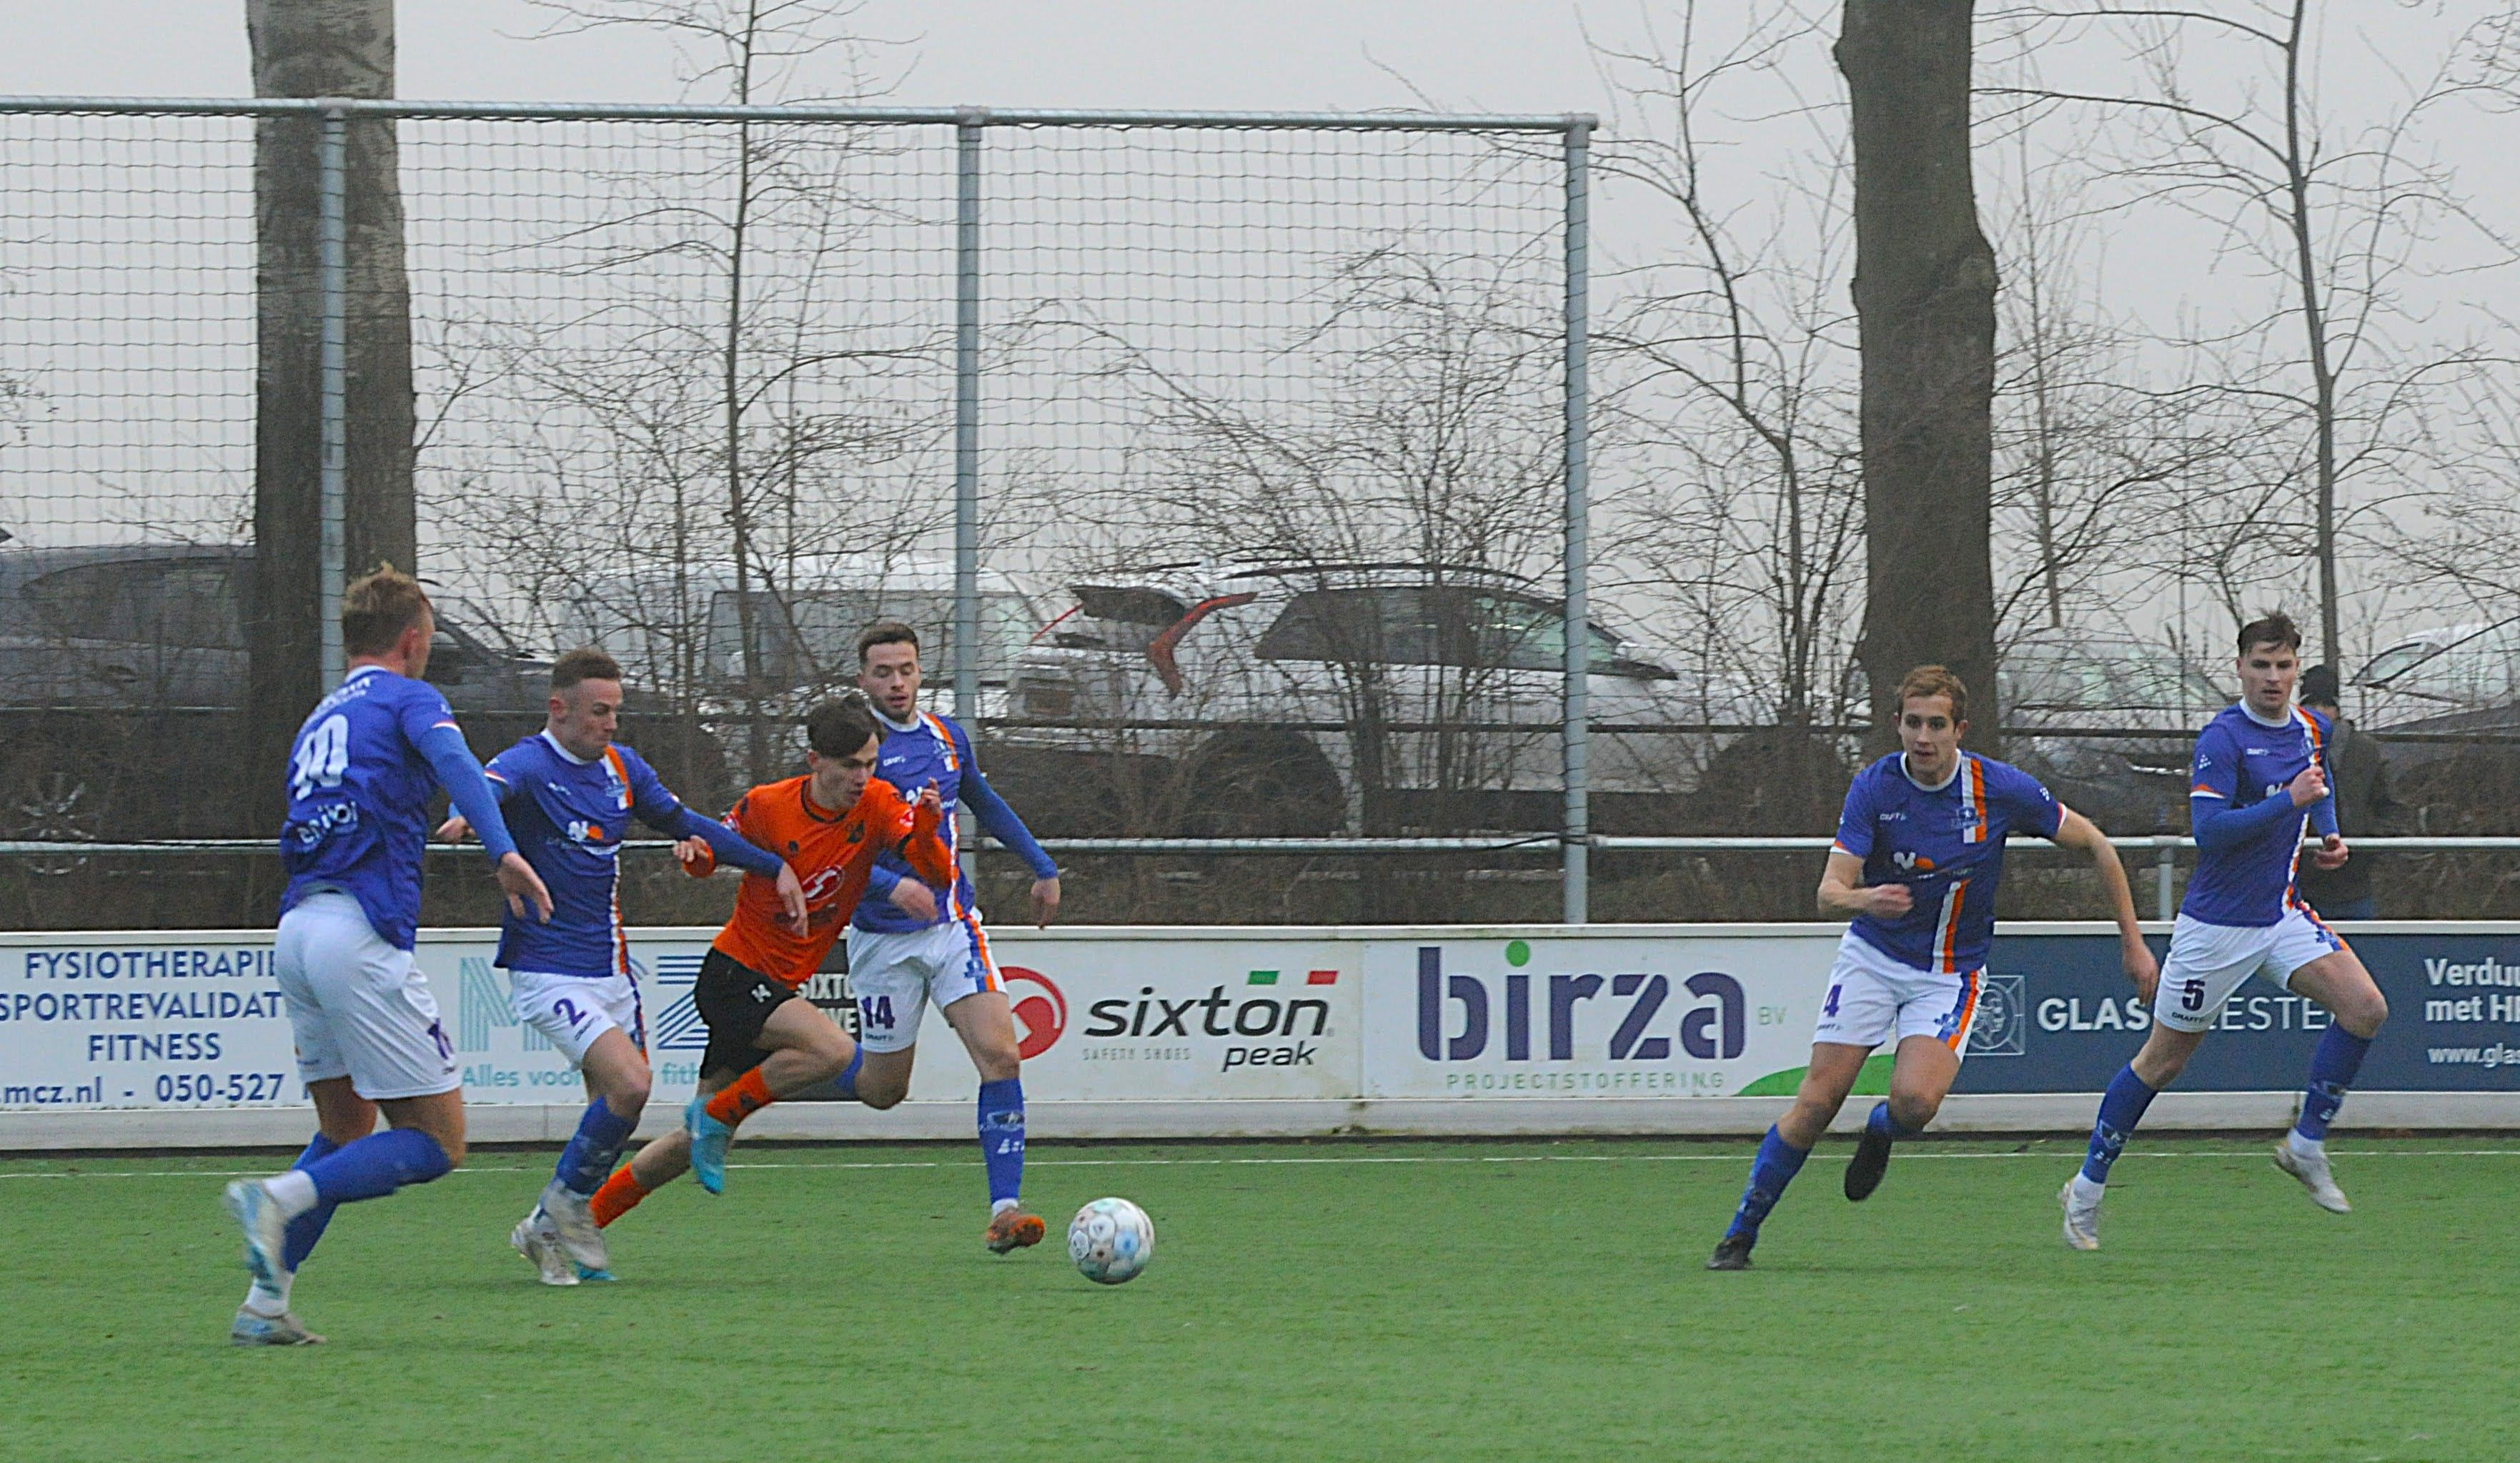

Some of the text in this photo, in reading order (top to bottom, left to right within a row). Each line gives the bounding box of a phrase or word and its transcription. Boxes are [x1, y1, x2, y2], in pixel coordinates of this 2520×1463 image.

[1417, 940, 1745, 1061] birza
[1823, 984, 1843, 1018] 4
[2181, 979, 2206, 1012] 5
[2425, 996, 2484, 1022] met
[553, 998, 587, 1028] 2
[860, 996, 896, 1029] 14
[1083, 985, 1329, 1037] sixton
[1759, 1006, 1787, 1026] BV
[89, 1033, 222, 1061] FITNESS
[1221, 1041, 1319, 1073] peak
[156, 1073, 285, 1102] 050-527
[463, 1063, 520, 1087] Alles
[1446, 1072, 1725, 1091] PROJECTSTOFFERING
